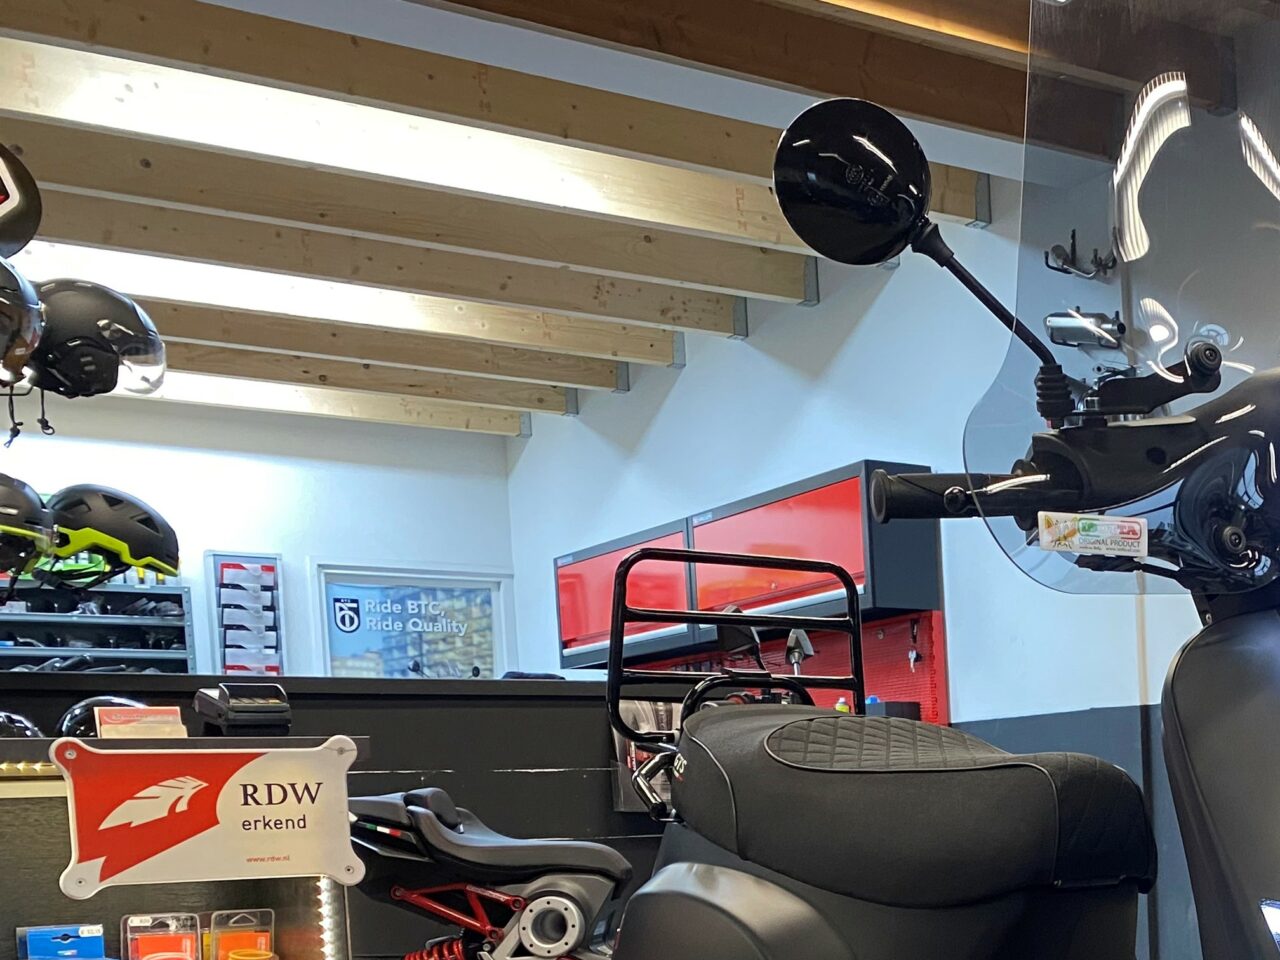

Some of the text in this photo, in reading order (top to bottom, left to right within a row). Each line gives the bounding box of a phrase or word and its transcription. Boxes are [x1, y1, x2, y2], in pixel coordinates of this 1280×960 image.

[1109, 539, 1141, 548] PRODUCT
[365, 599, 445, 617] Ride BTC,
[366, 617, 468, 637] Ride Quality
[239, 782, 323, 806] RDW
[241, 814, 307, 831] erkend
[245, 854, 291, 863] www.rdw.nl
